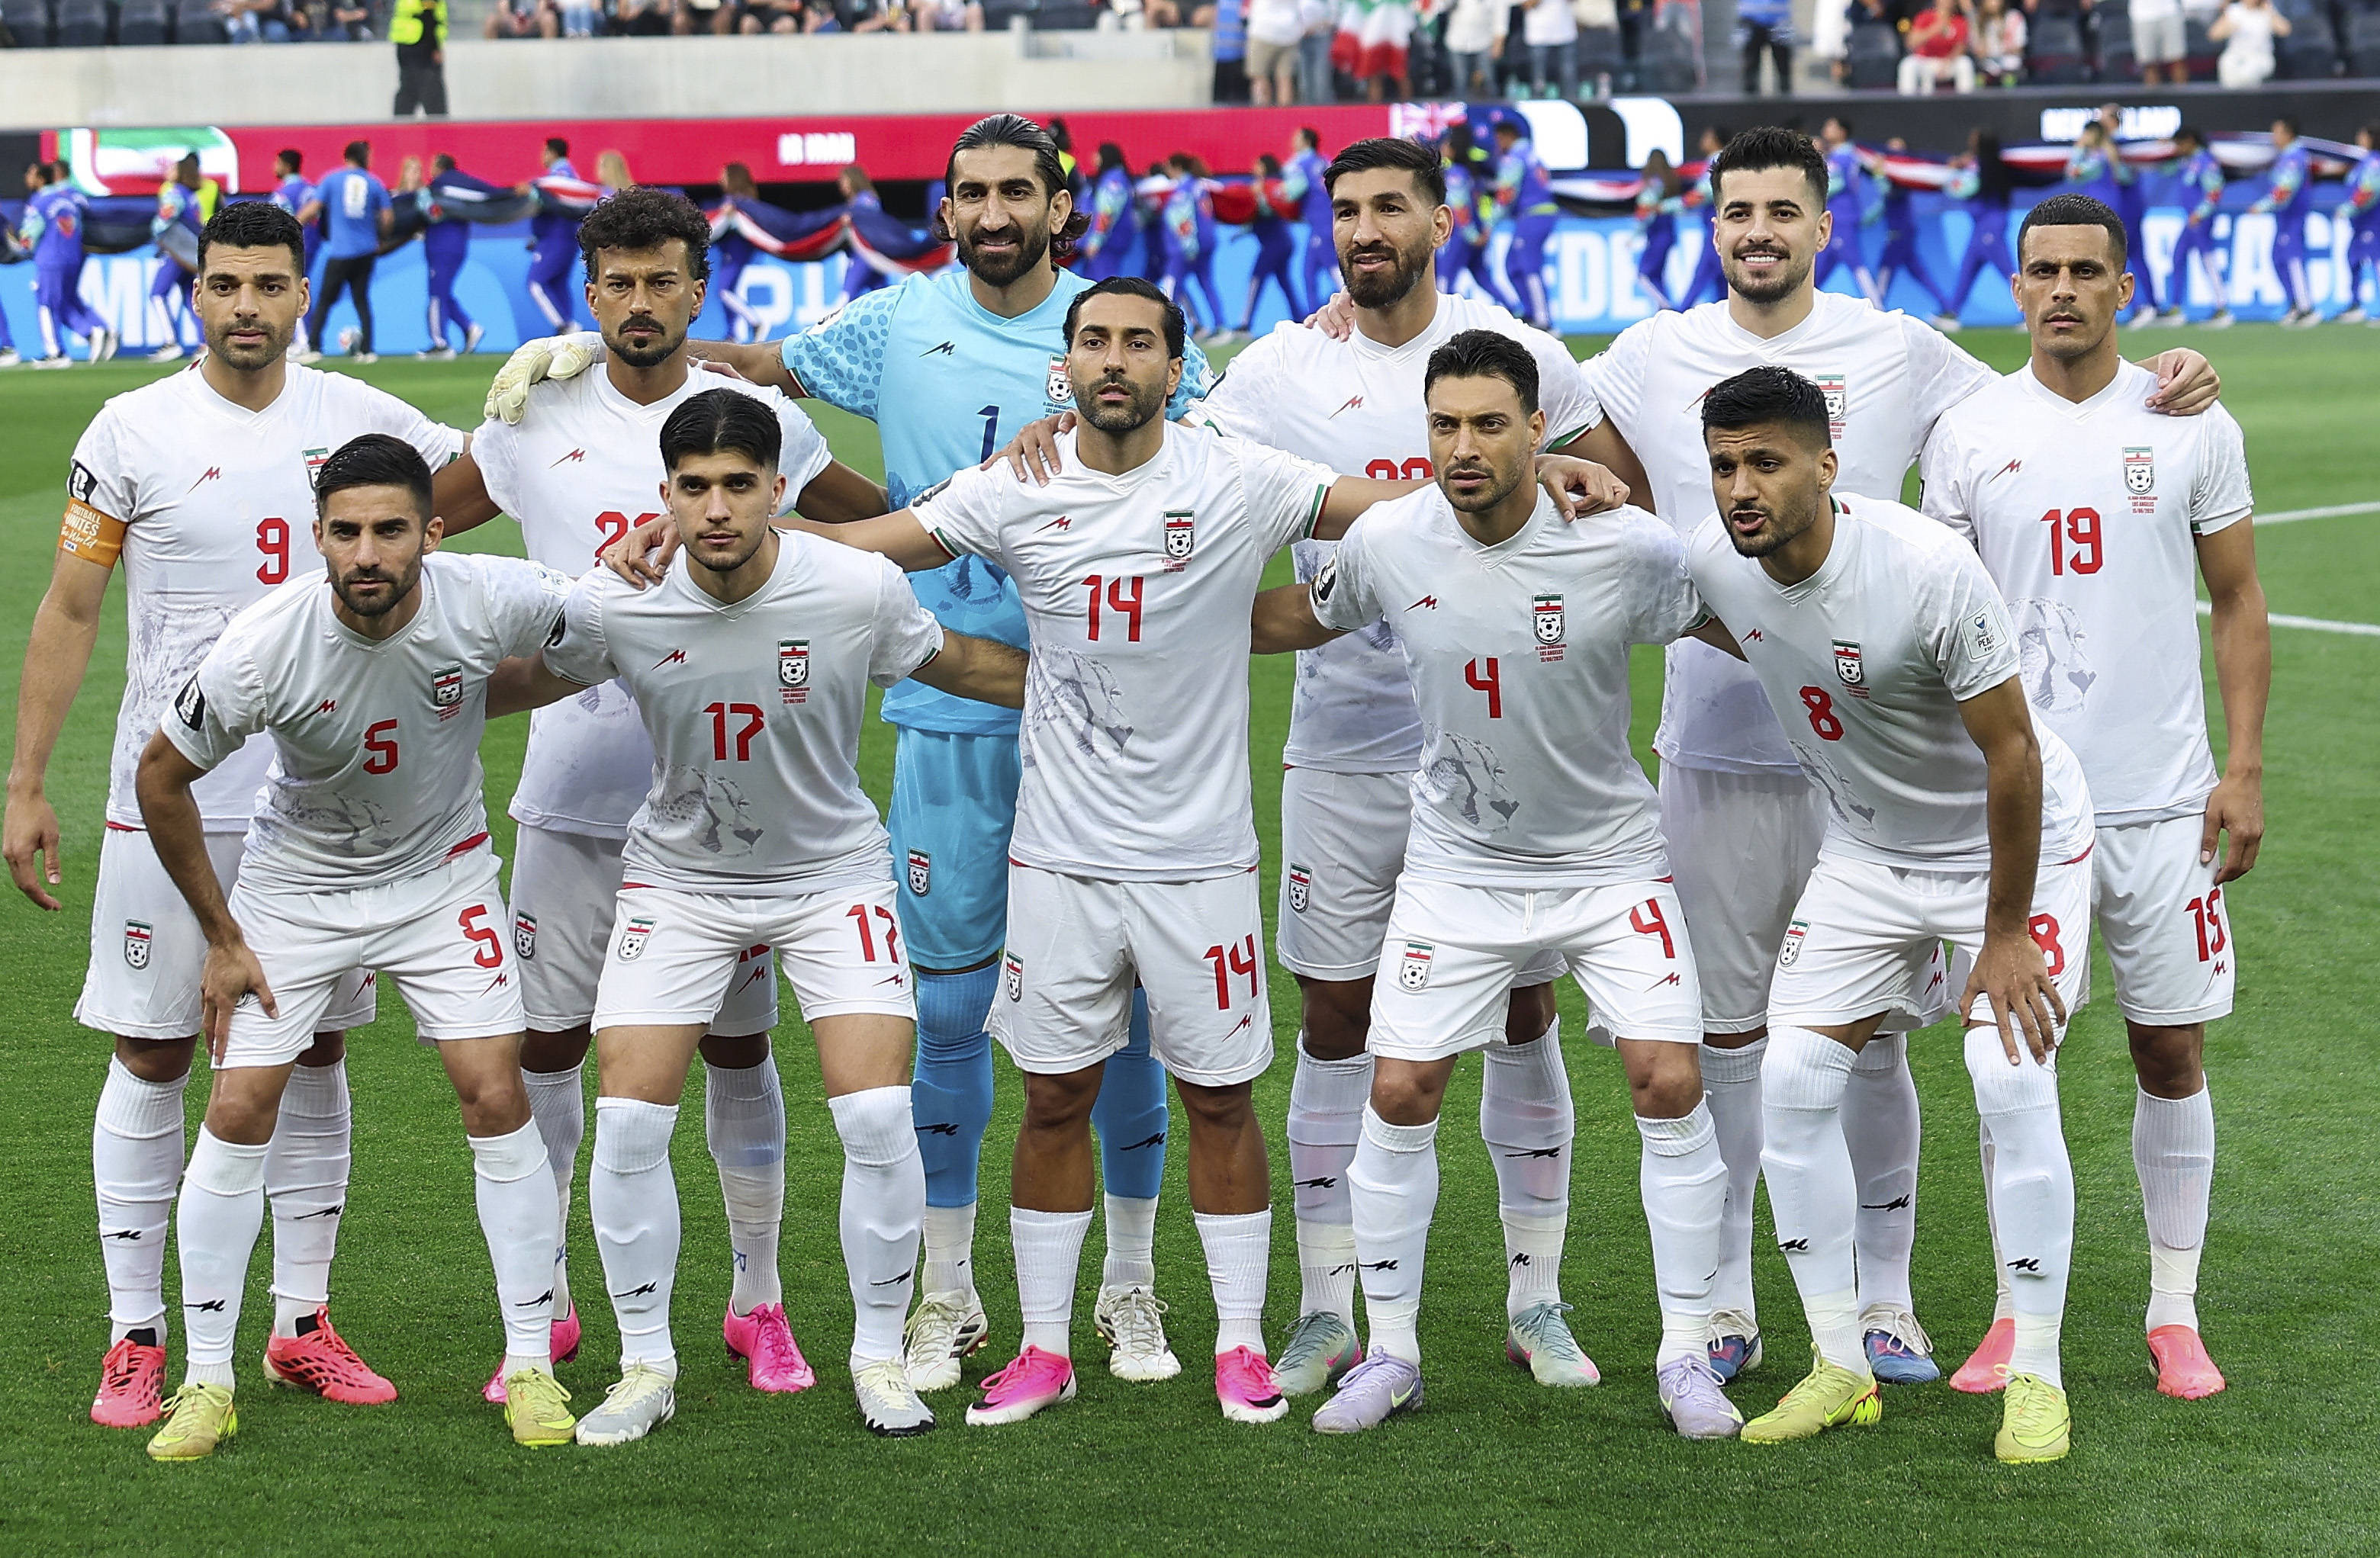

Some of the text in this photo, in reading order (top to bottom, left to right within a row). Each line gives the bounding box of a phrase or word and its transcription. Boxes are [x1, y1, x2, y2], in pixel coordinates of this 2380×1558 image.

[976, 404, 999, 463] 1
[64, 511, 100, 537] UNITES
[70, 503, 101, 525] FOOTBALL
[594, 511, 661, 558] 2
[2041, 507, 2103, 576] 19
[257, 518, 290, 585] 9
[1082, 575, 1143, 642] 14
[1465, 657, 1502, 718] 4
[1799, 686, 1844, 741] 8
[363, 719, 398, 775] 5
[703, 702, 764, 761] 17
[458, 904, 503, 969] 5
[845, 904, 899, 964] 17
[1629, 898, 1675, 959] 4
[2029, 913, 2065, 977] 8
[2183, 888, 2226, 962] 19
[1204, 934, 1257, 1010] 14
